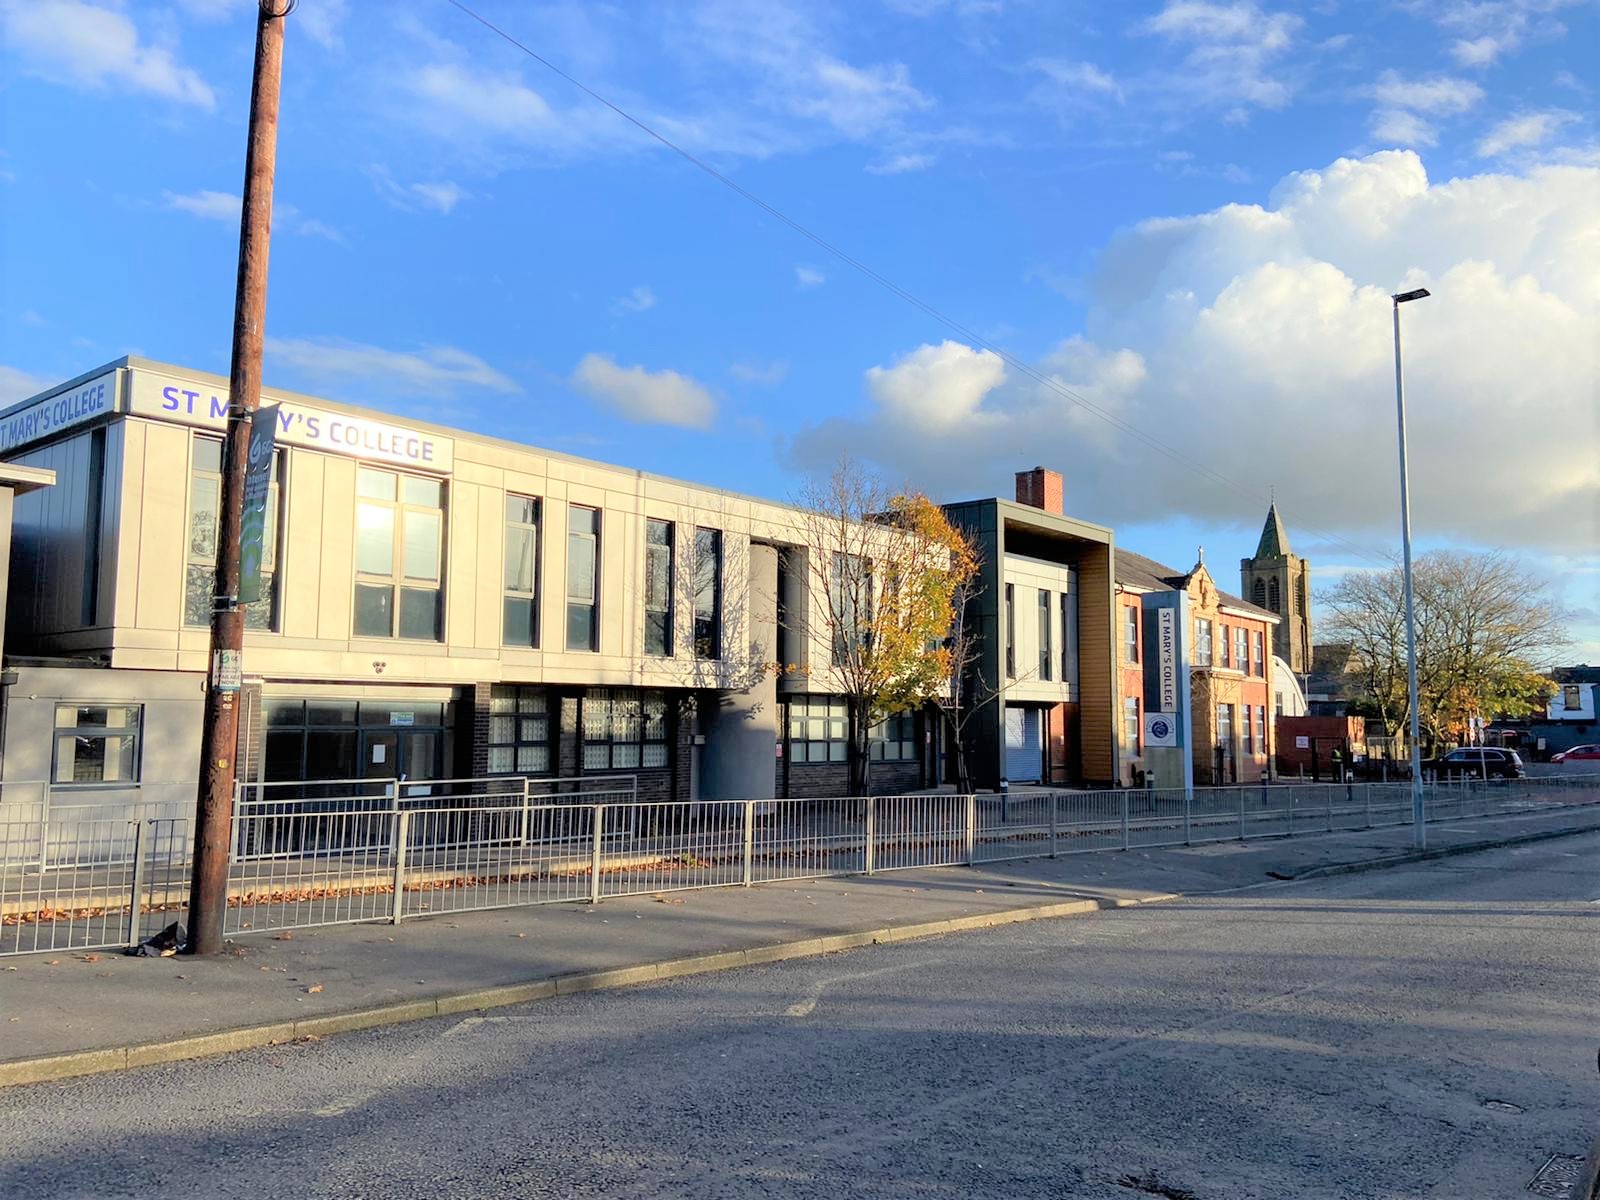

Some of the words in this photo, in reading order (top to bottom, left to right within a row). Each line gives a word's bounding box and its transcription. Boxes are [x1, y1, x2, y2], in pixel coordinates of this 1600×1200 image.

[9, 406, 51, 442] MARY'S
[53, 383, 105, 426] COLLEGE
[162, 386, 199, 414] ST
[209, 396, 320, 439] MY'S
[329, 422, 434, 461] COLLEGE
[1162, 612, 1171, 624] ST
[1162, 626, 1172, 663] MARY'S
[1163, 666, 1173, 708] COLLEGE
